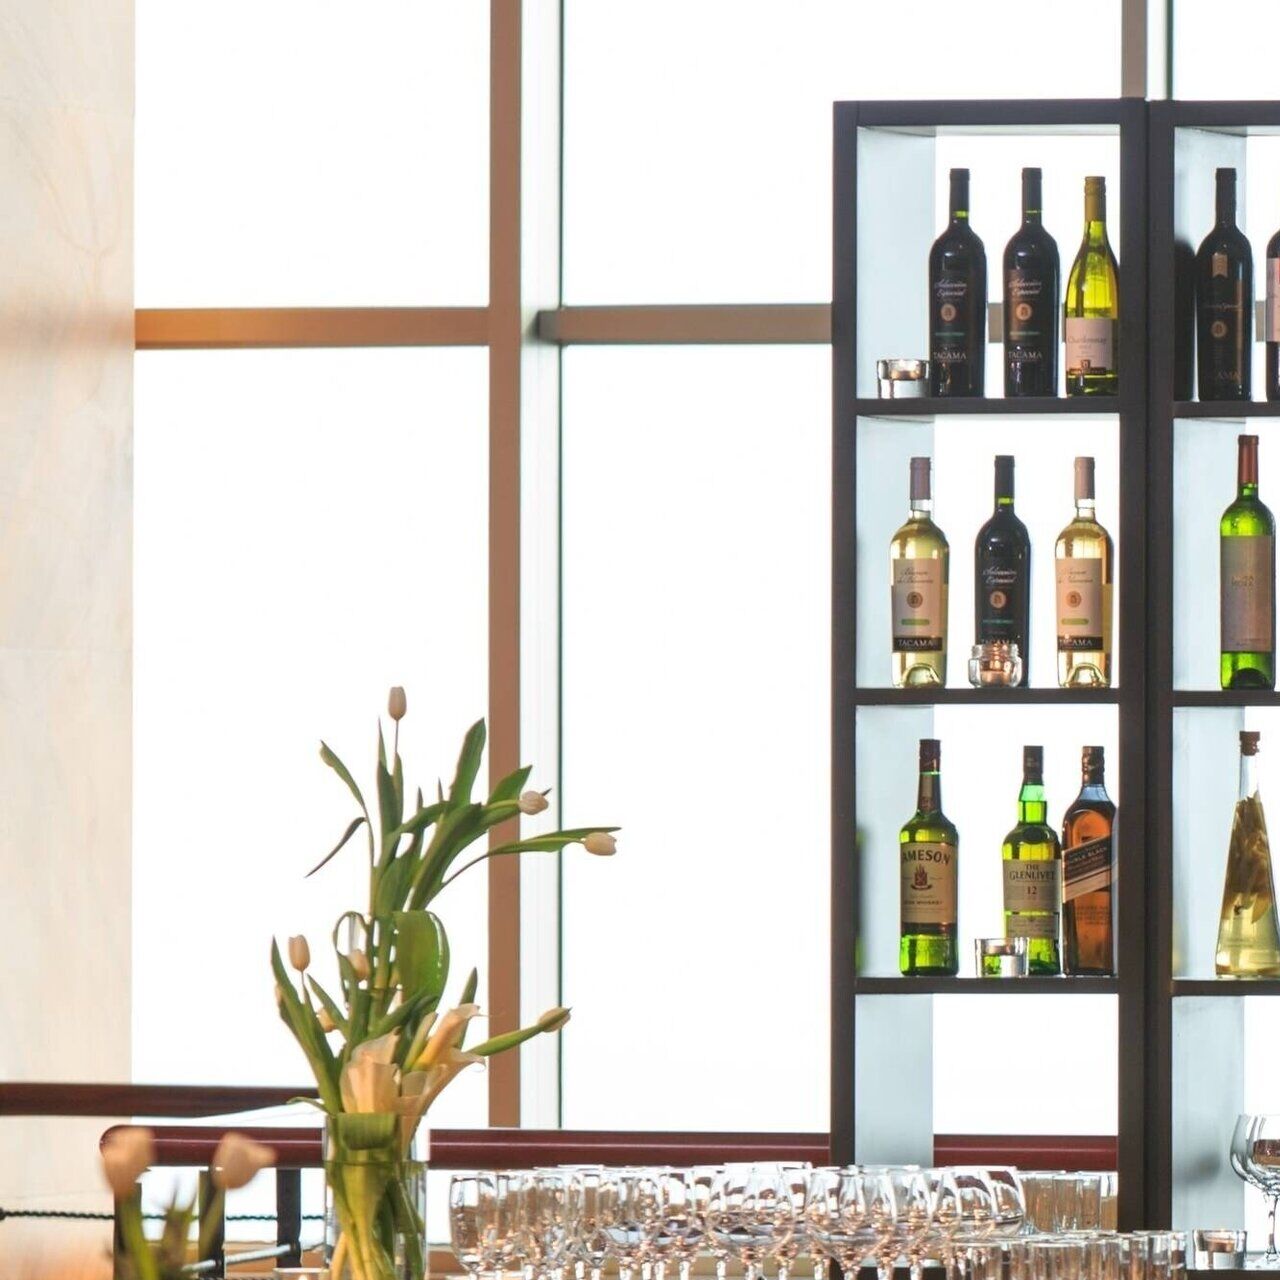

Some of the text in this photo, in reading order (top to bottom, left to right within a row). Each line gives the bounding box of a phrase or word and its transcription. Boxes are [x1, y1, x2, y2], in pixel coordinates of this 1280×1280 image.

[902, 849, 951, 865] AMESON
[1009, 871, 1056, 881] GLENLIVET
[1027, 886, 1037, 895] 12
